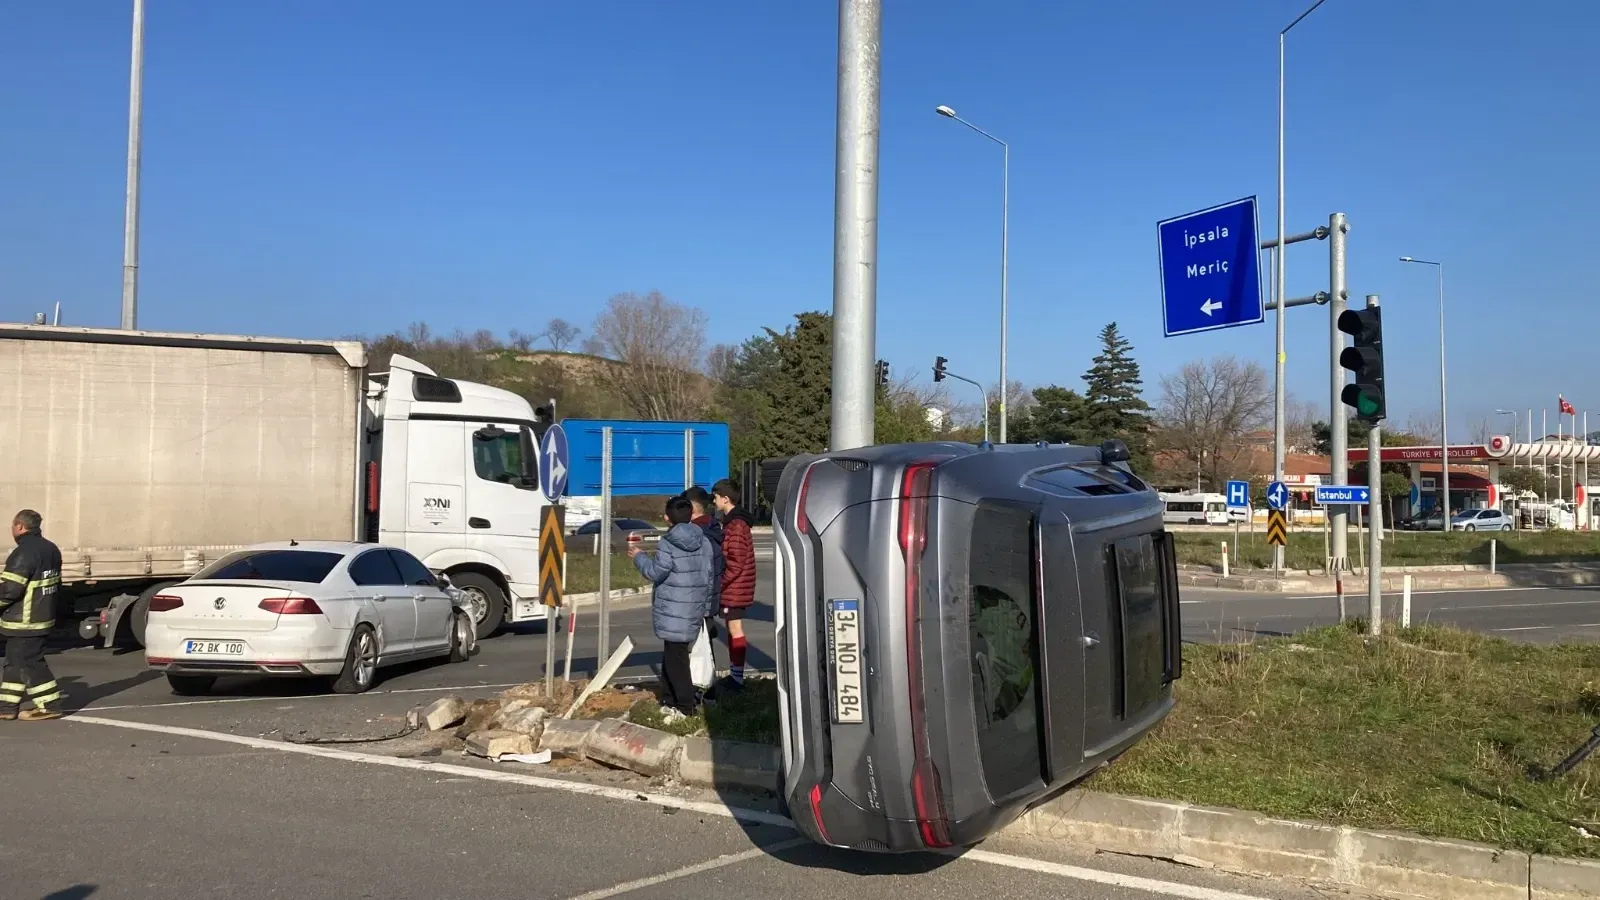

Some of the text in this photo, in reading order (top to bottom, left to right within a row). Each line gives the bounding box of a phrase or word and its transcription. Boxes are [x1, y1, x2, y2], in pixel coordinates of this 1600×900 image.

[1184, 225, 1229, 249] İpsala
[1186, 260, 1229, 278] Meriç
[1402, 449, 1478, 458] TÜRKİYE PEROLLERİ
[1231, 484, 1244, 503] H
[1318, 487, 1352, 499] İstanbul
[838, 602, 845, 610] TR
[192, 642, 243, 653] 22 BK 100
[837, 612, 860, 716] 34 NOJ 484
